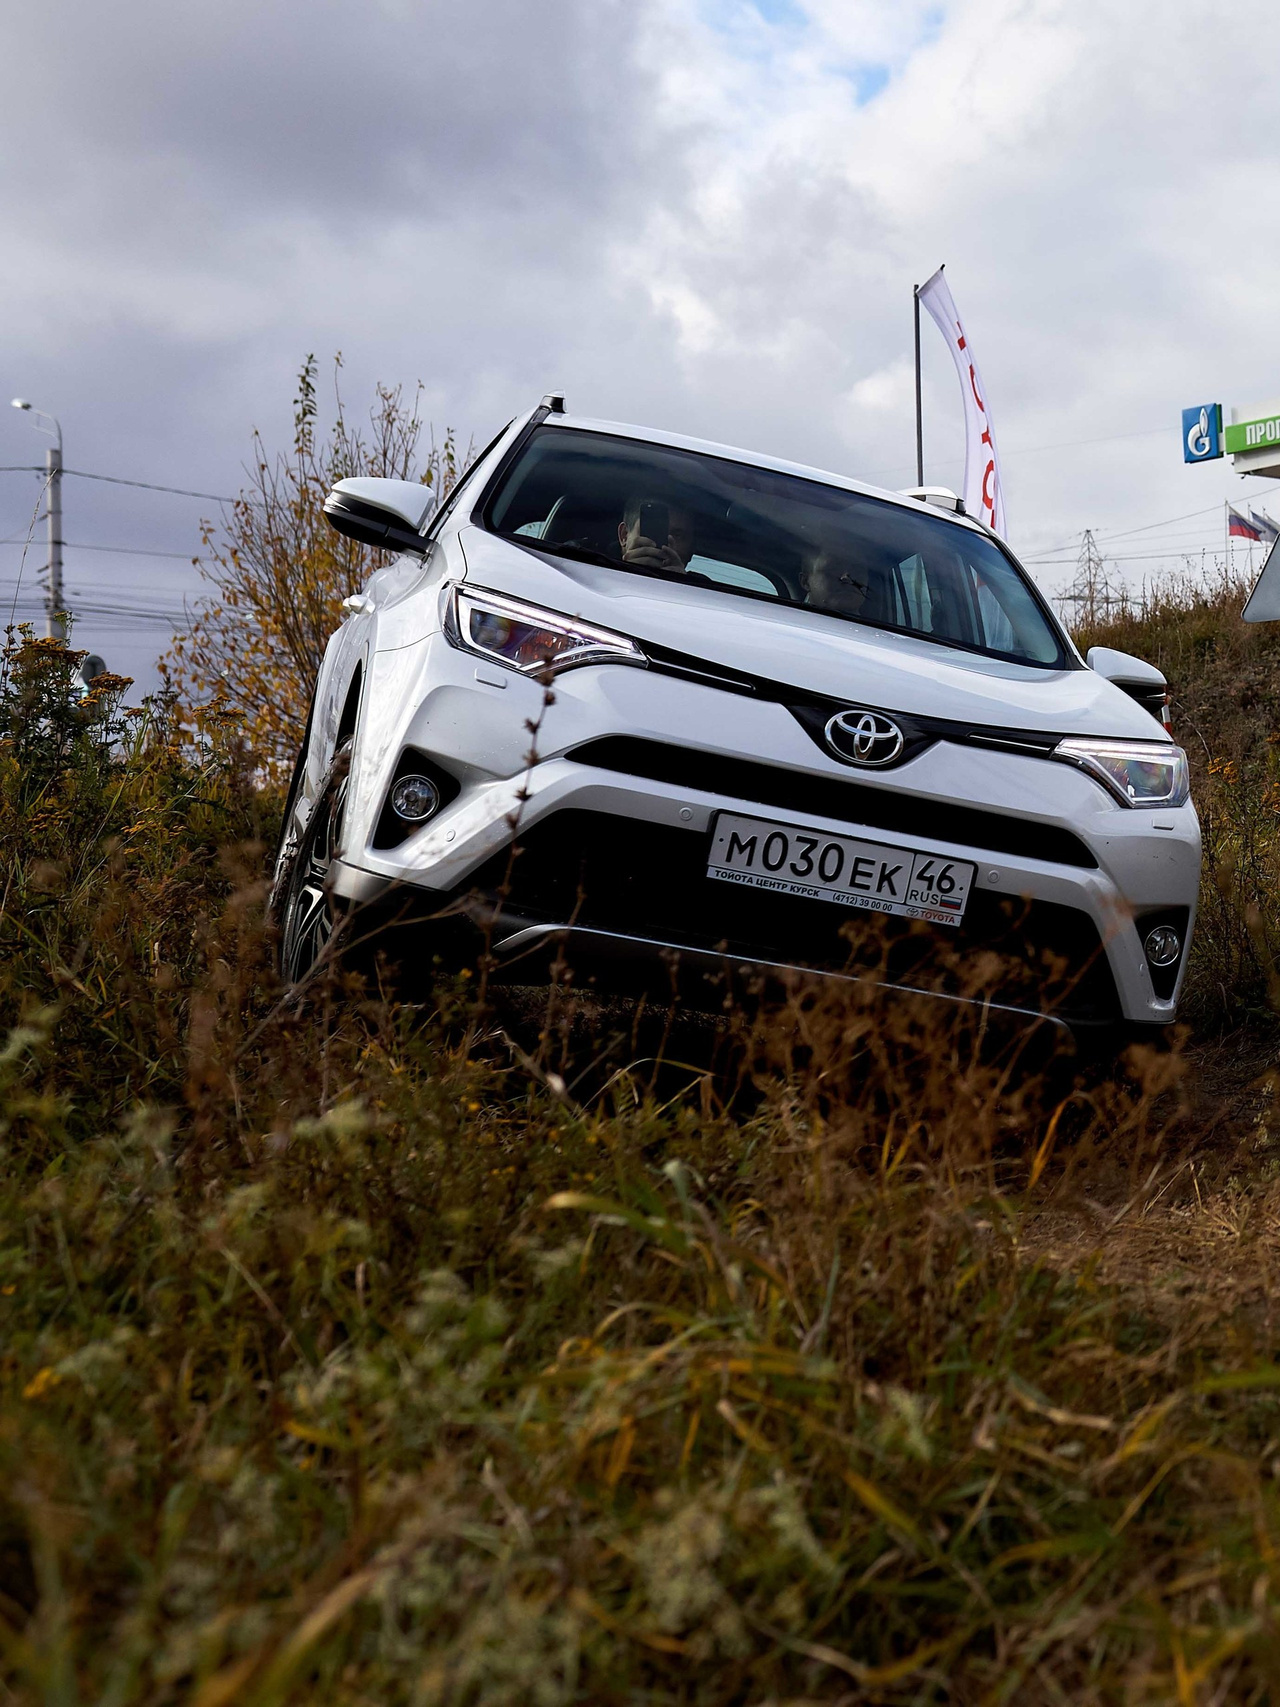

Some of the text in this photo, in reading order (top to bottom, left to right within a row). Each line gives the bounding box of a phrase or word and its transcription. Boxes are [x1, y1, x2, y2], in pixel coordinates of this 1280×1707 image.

[715, 869, 820, 897] ТОЙОТА ЦЕНТР КУРСК
[916, 860, 955, 894] 46
[833, 892, 893, 912] (4712) 39 00 00
[910, 889, 939, 905] RUS
[920, 910, 955, 924] TOYOTA
